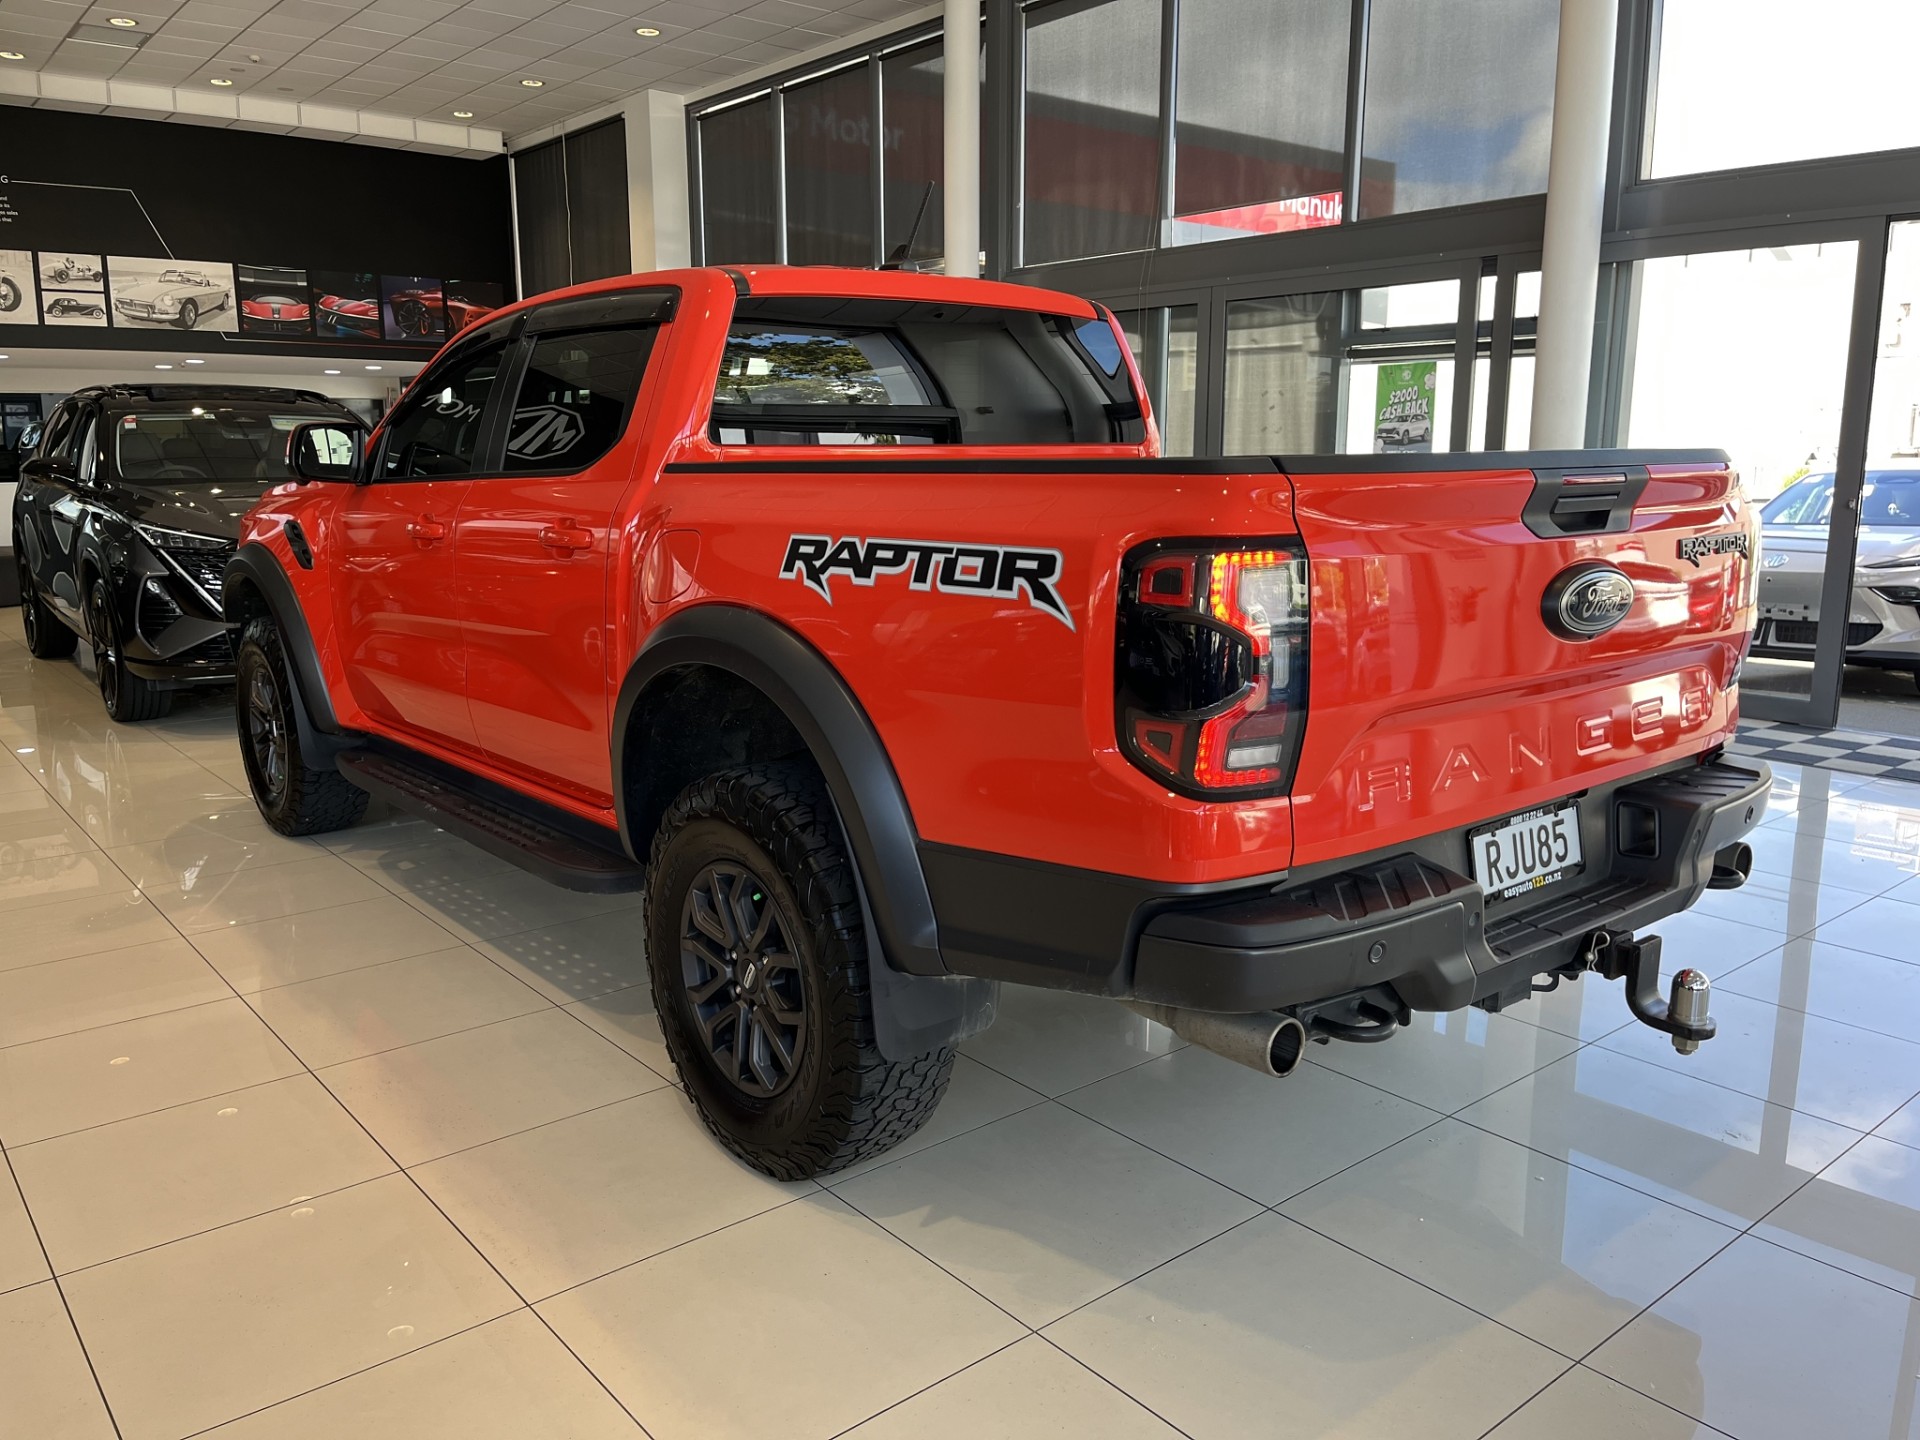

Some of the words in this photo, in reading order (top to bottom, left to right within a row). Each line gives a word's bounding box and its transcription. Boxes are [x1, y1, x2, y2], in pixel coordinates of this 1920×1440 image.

[807, 103, 904, 152] Motr
[1379, 404, 1403, 421] CASH
[1405, 397, 1429, 415] BACK
[1389, 385, 1418, 405] $2000
[1677, 532, 1748, 568] RAPTOR
[777, 533, 1077, 633] RAPTOR
[1582, 584, 1624, 619] Ford
[1357, 687, 1712, 813] RANGER
[1485, 818, 1568, 887] RJU85
[1504, 871, 1562, 898] easyauto123.co.nz
